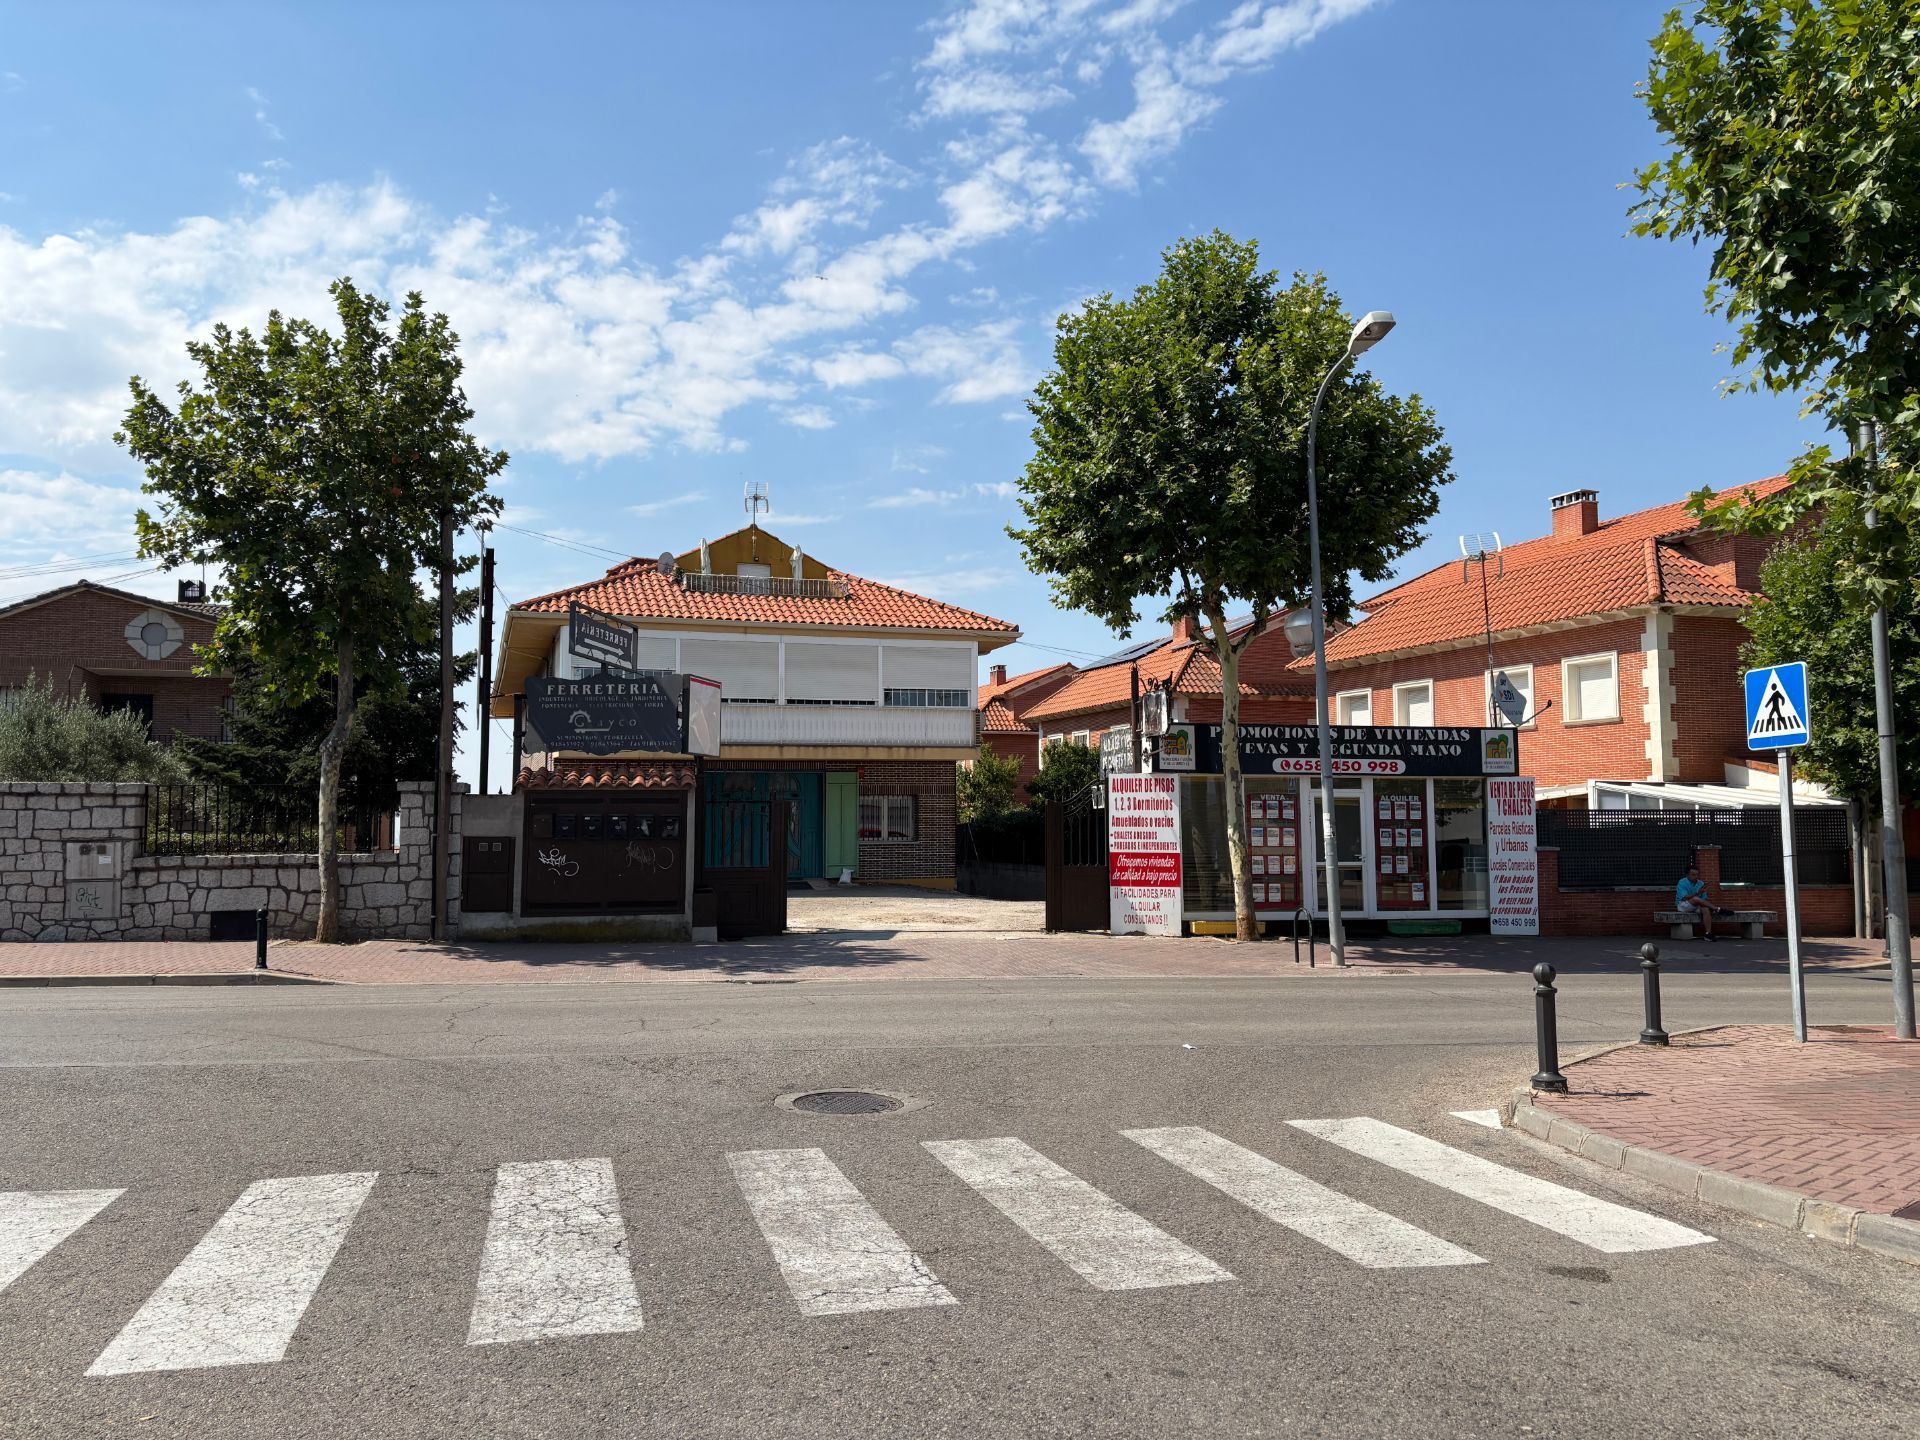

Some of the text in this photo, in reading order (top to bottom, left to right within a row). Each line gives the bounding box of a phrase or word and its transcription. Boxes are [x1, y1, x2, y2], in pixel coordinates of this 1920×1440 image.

[547, 684, 660, 695] FERRETERIA
[1210, 726, 1470, 741] POMOCIONS DE VIVIENDAS
[1298, 743, 1308, 754] Y
[1317, 744, 1402, 756] EGUNDA
[1411, 744, 1462, 756] MANO
[1293, 760, 1398, 772] 658 450 998
[1112, 778, 1175, 794] ALQUILER DE PISOS
[1490, 781, 1534, 798] VENTA DE PISOS
[1133, 797, 1173, 811] Dormitorios
[1497, 799, 1531, 816] Y CHALETS
[1112, 814, 1148, 827] Amueblados
[1489, 821, 1511, 835] Parcelas
[1114, 831, 1132, 839] CHALETS
[1501, 838, 1528, 851] Urbanas
[1117, 855, 1174, 867] Ofrecemos viviendas
[1490, 858, 1535, 871] Locales Comerciales
[1112, 869, 1119, 880] de
[1120, 868, 1141, 880] calidad
[1146, 868, 1158, 884] bajo
[1157, 869, 1177, 885] precio
[1512, 874, 1534, 884] bajado
[1120, 888, 1158, 899] FACILIDADES
[1160, 889, 1176, 899] PARA
[1498, 885, 1533, 894] los Precios
[1131, 901, 1160, 911] ALQUILAR
[1499, 918, 1536, 927] 658 450 998
